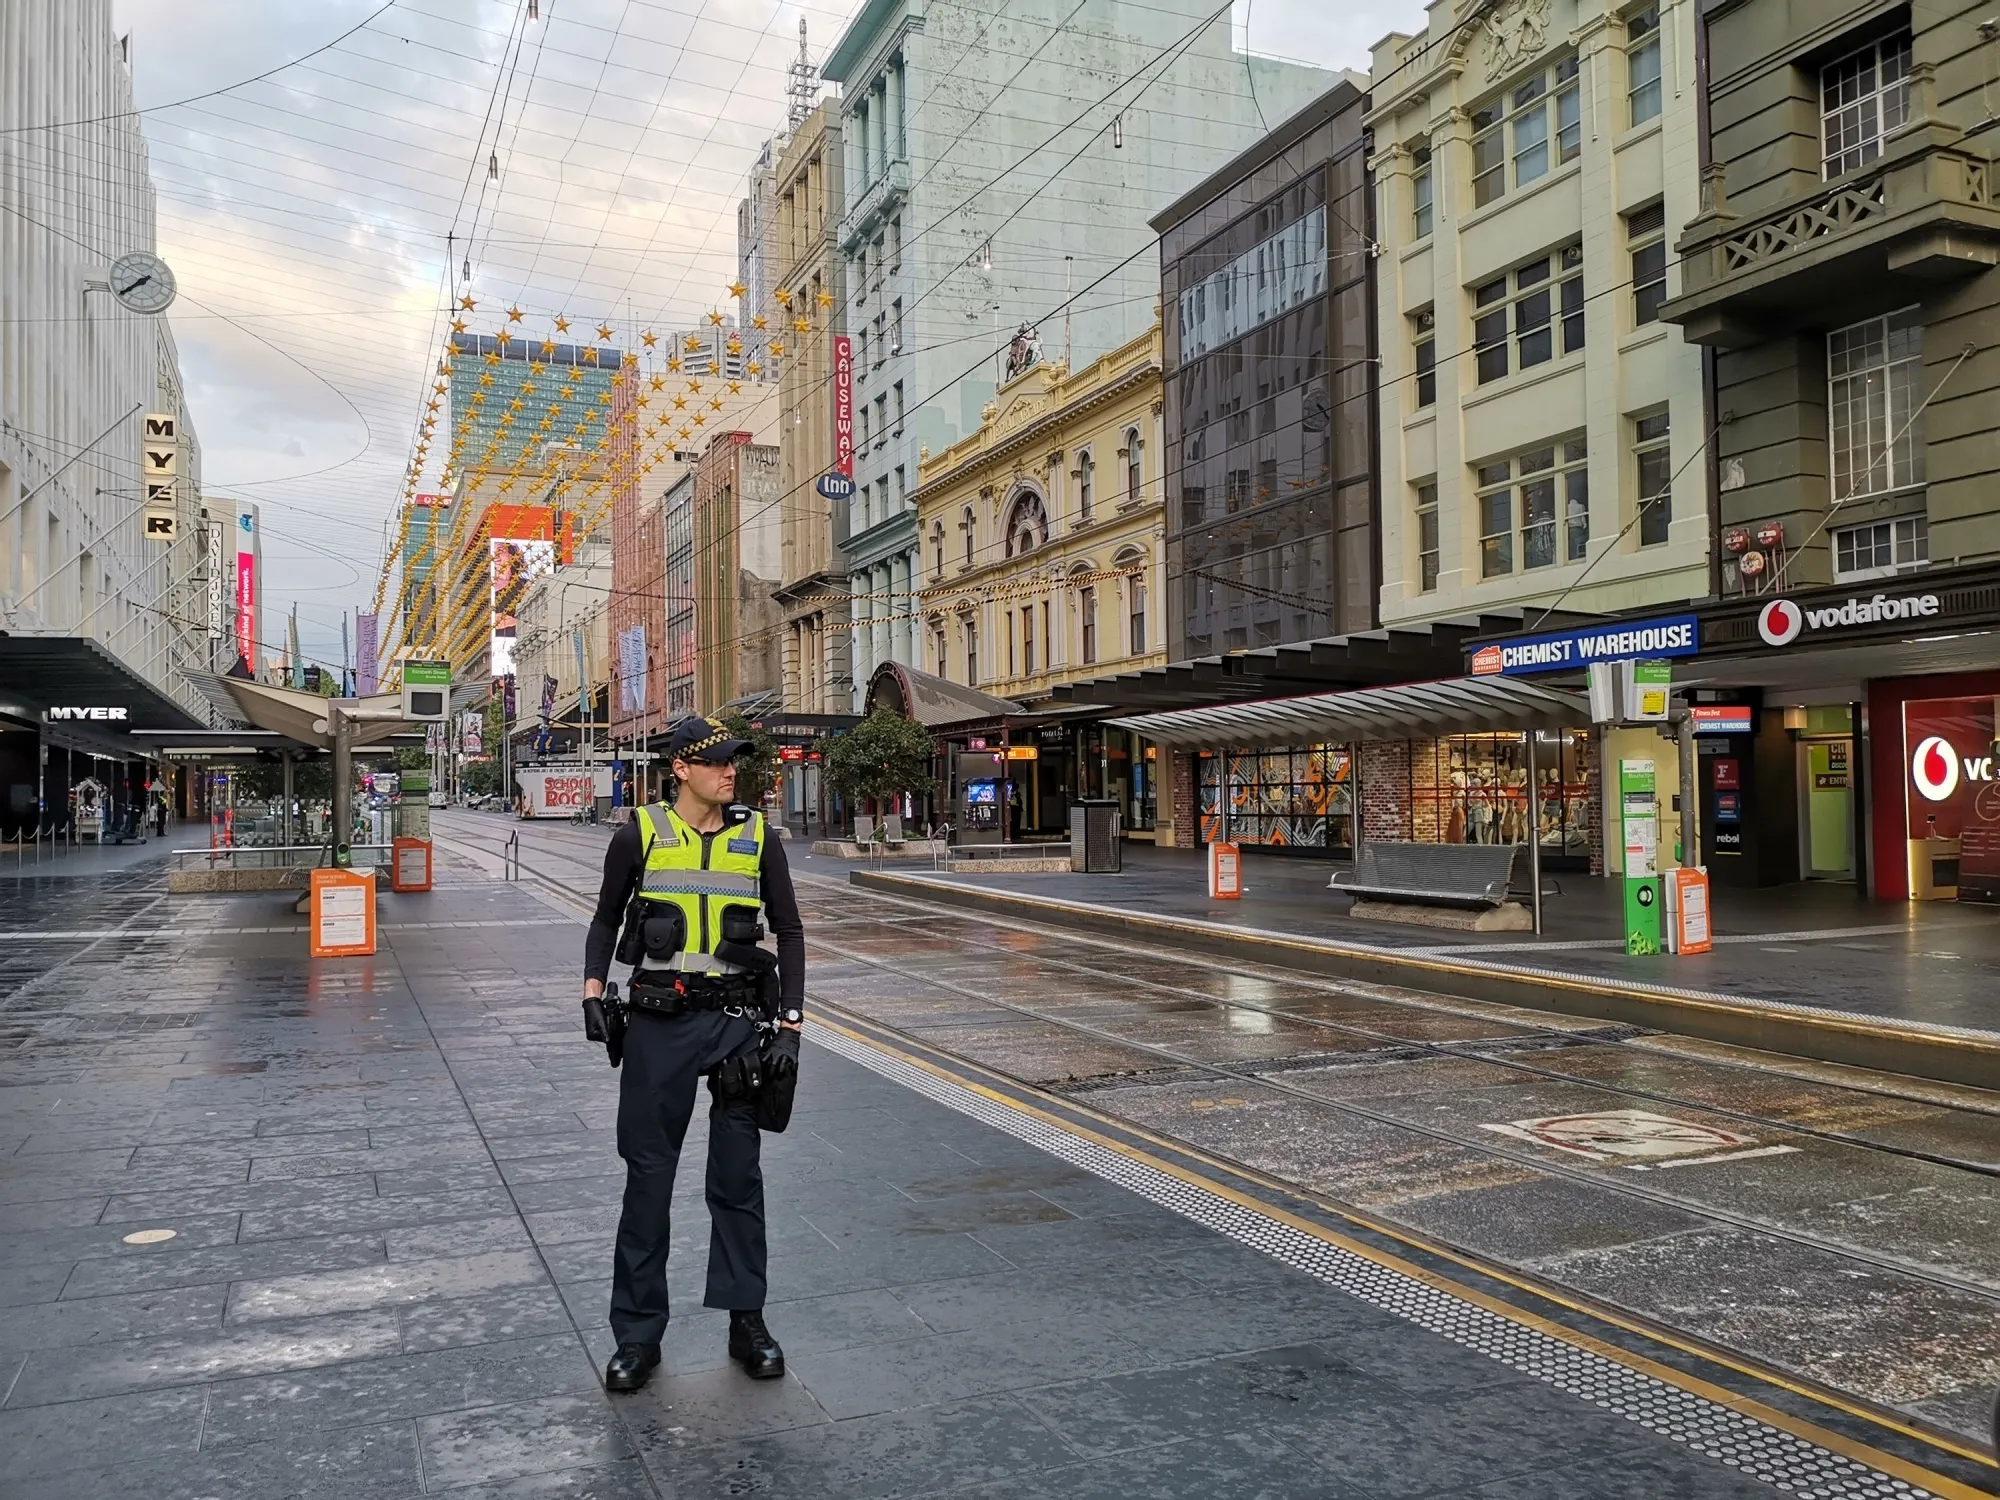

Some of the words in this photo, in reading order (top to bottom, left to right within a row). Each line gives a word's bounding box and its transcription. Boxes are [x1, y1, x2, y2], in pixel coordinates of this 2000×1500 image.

[837, 342, 851, 465] CAUSEWAY
[146, 418, 174, 534] MYER
[824, 475, 850, 493] Inn
[210, 528, 221, 578] DAVID
[209, 580, 221, 633] JONES
[243, 602, 249, 611] of
[1806, 594, 1939, 629] vodafone
[241, 616, 249, 634] kind
[1503, 640, 1573, 667] CHEMIST
[1578, 623, 1692, 659] WAREHOUSE
[1474, 655, 1500, 666] CHEMIST
[50, 707, 128, 720] MYER
[1716, 834, 1740, 843] rebel
